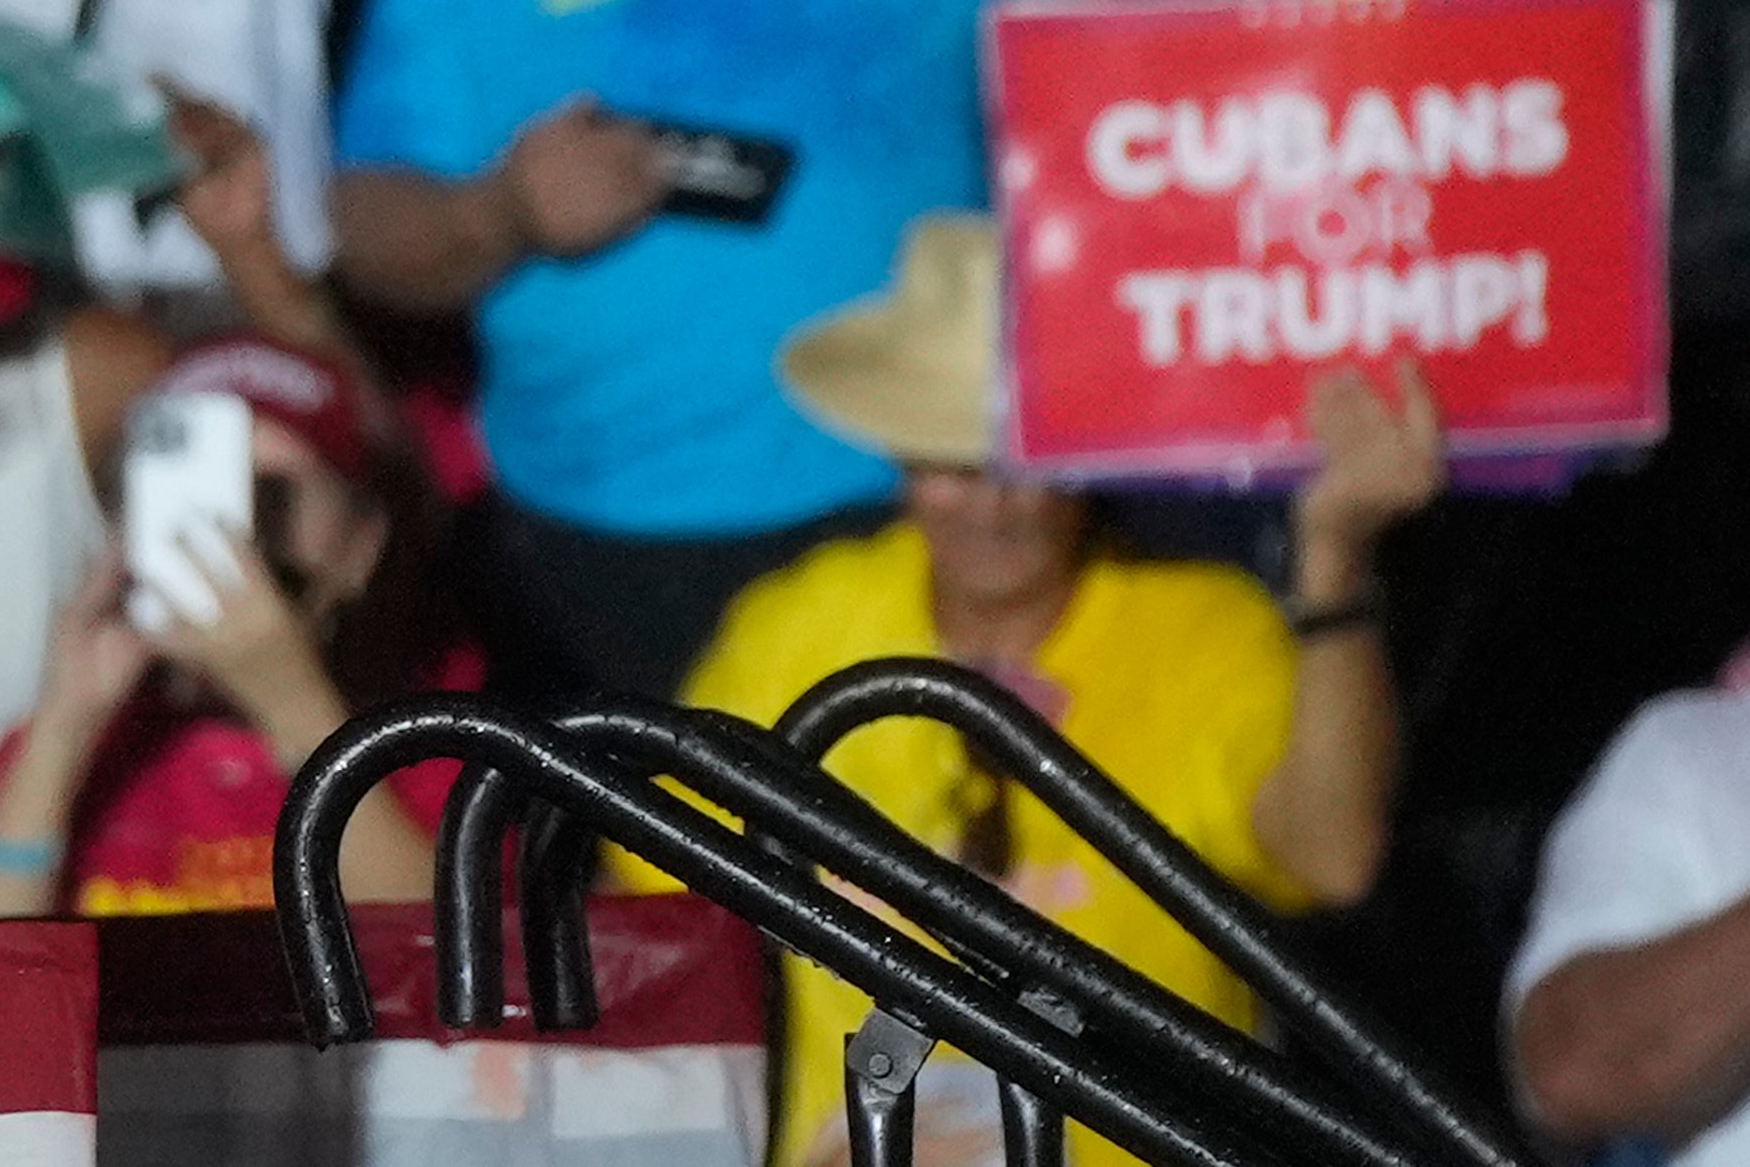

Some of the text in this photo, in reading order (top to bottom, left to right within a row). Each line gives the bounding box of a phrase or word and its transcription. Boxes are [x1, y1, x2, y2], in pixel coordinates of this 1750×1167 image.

[1086, 78, 1569, 201] CUBANS
[1237, 170, 1434, 263] FOR
[1116, 250, 1549, 367] TRUMP!
